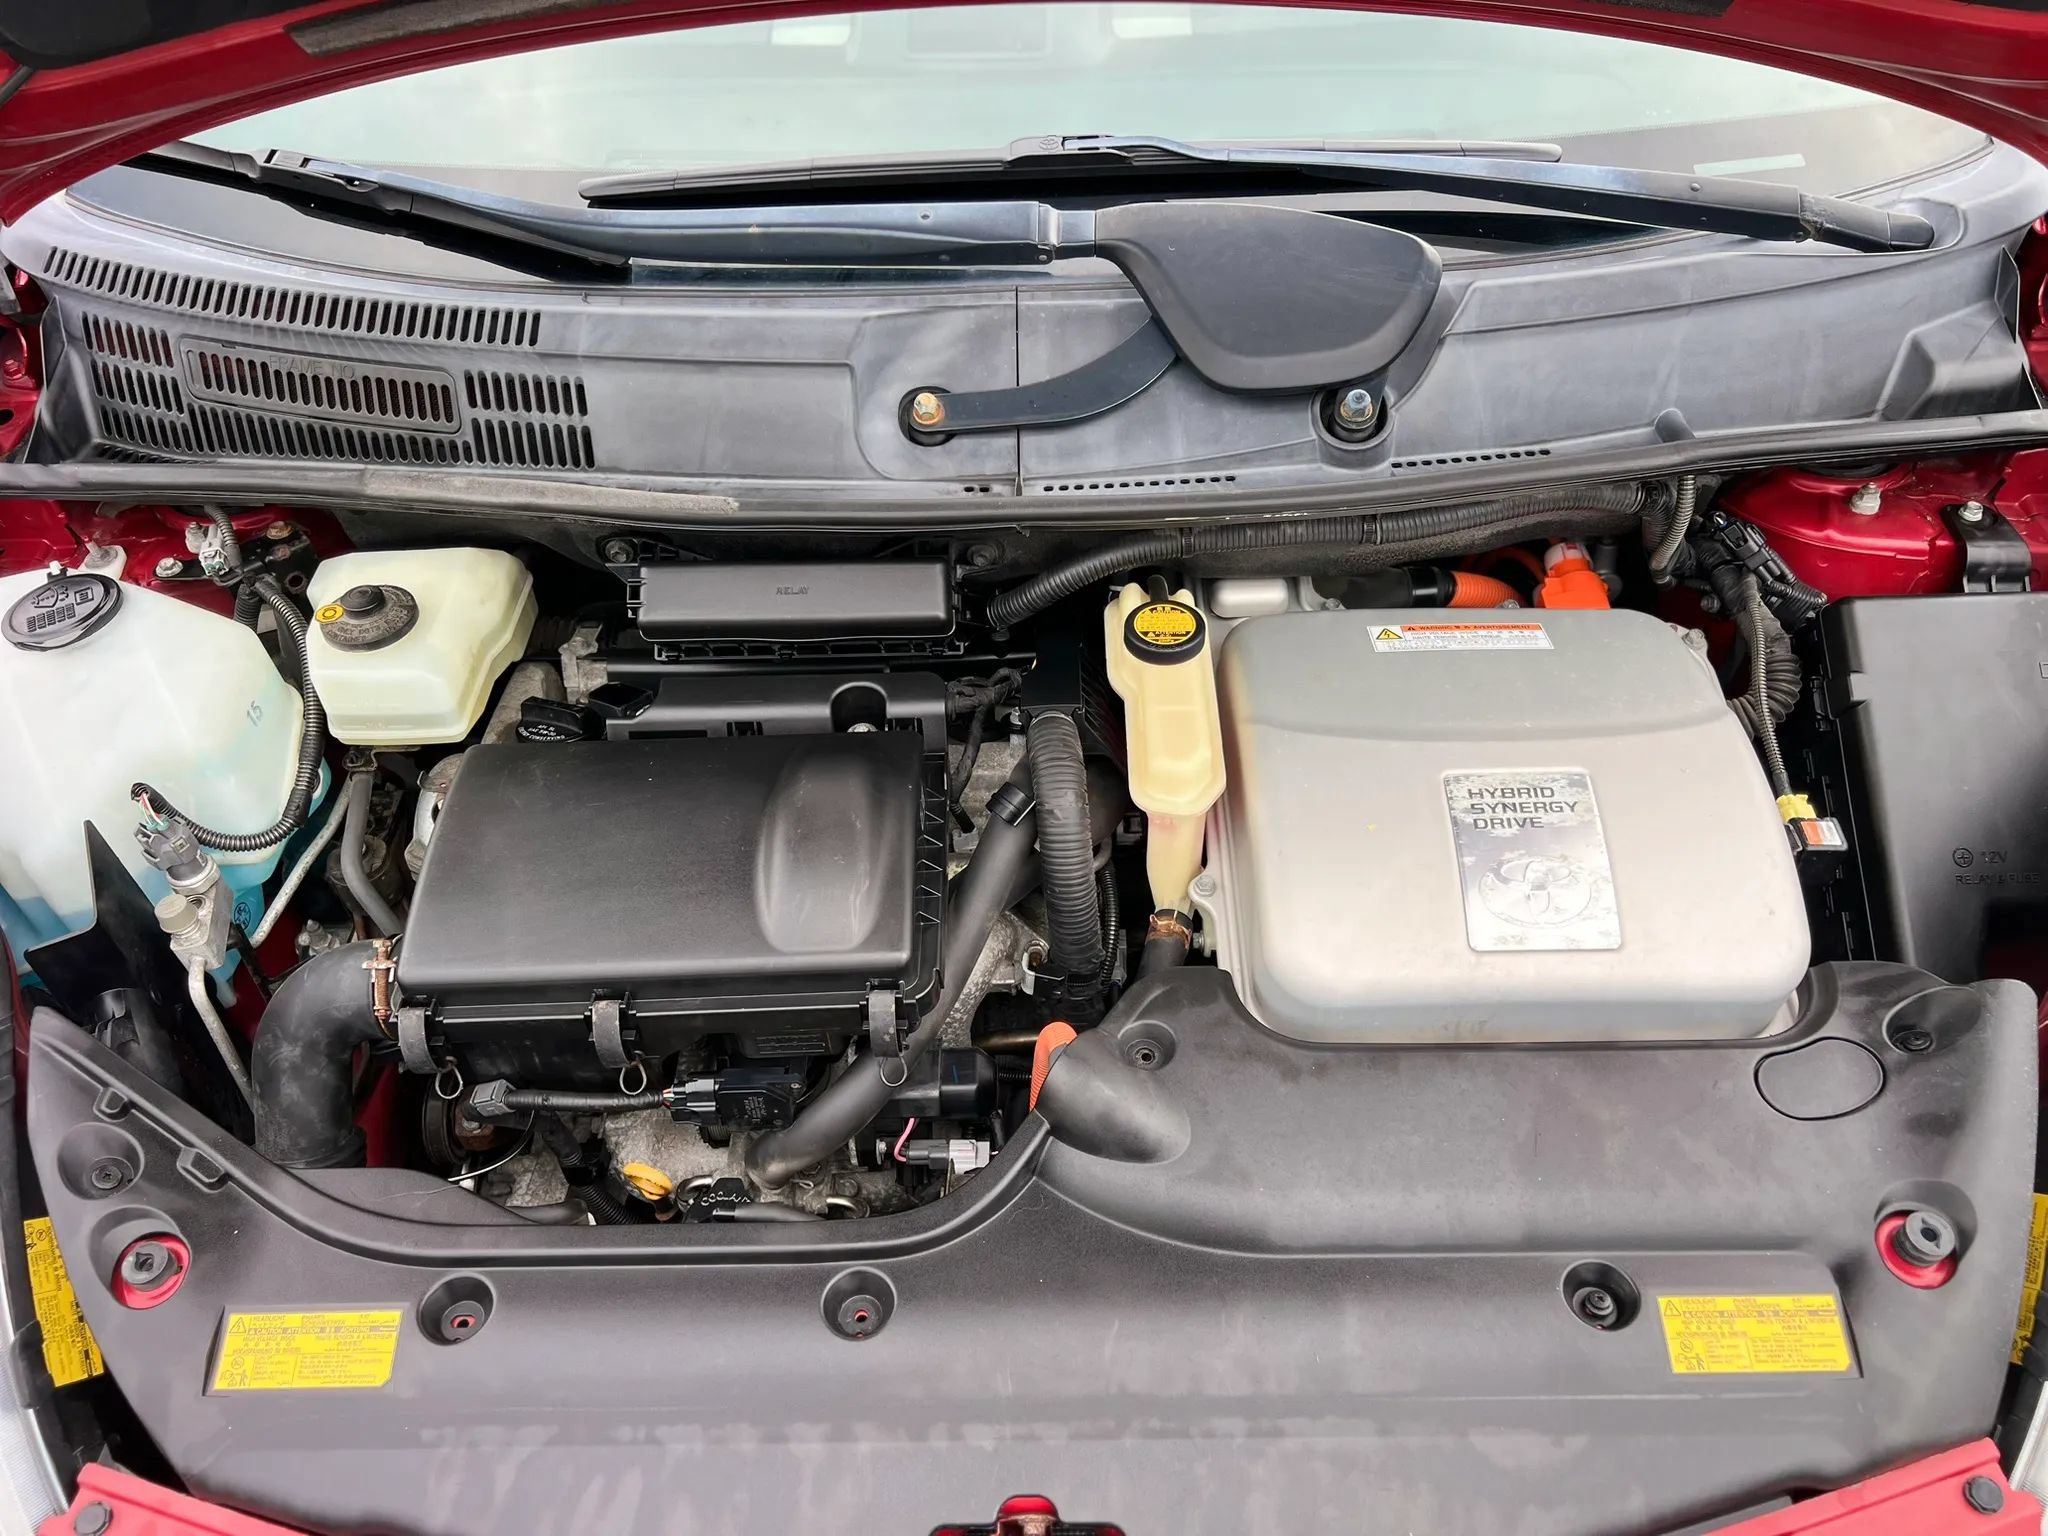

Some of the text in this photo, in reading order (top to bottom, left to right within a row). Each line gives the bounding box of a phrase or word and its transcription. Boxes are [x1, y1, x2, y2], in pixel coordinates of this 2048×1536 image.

[269, 355, 323, 375] FRAME
[776, 585, 810, 595] RELAY
[1467, 786, 1555, 800] HYBRID
[1470, 800, 1578, 815] SYNERGY
[1473, 816, 1545, 830] DRIVE
